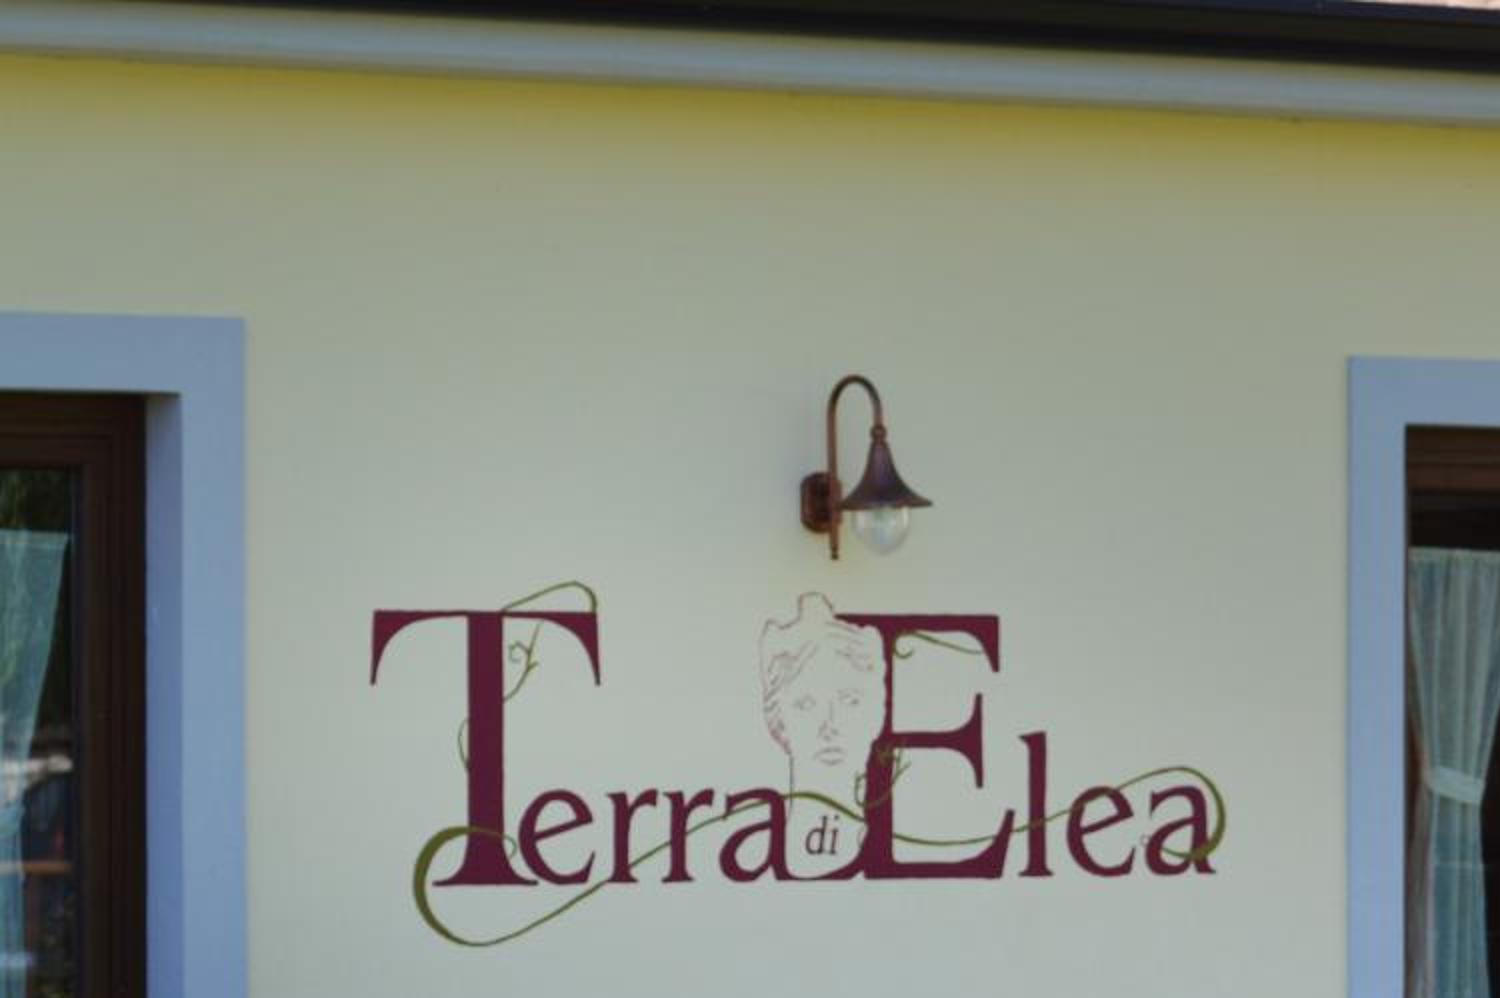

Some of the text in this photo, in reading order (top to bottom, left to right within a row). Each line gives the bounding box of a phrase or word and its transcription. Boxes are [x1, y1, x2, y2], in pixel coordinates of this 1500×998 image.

[370, 609, 1217, 888] Terra di Elea
